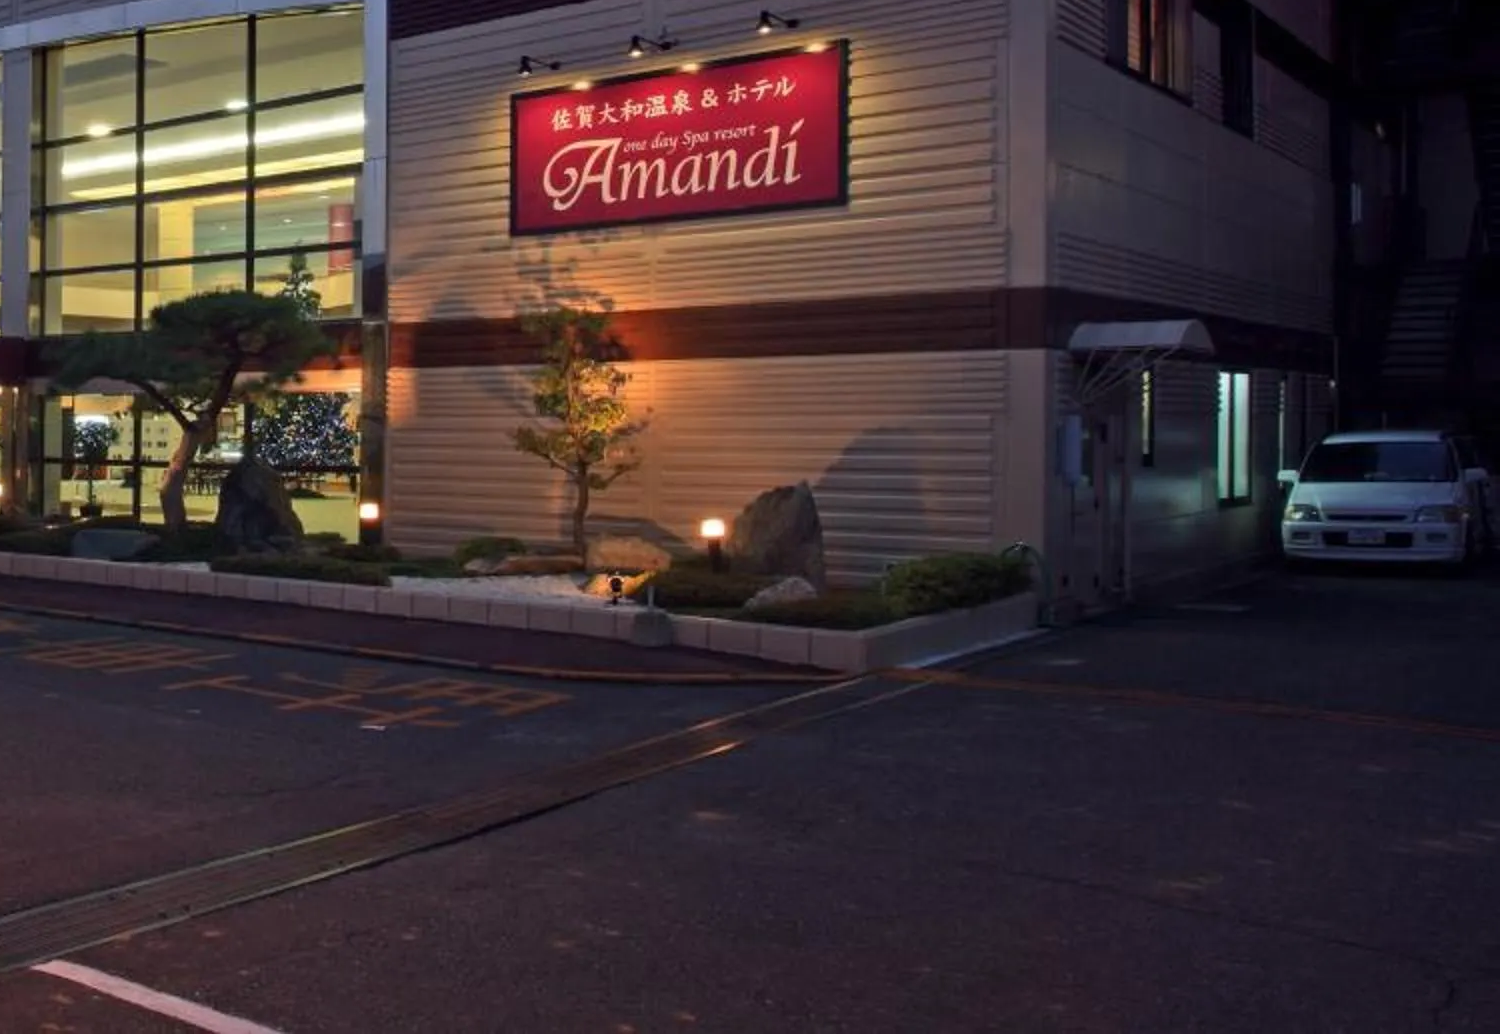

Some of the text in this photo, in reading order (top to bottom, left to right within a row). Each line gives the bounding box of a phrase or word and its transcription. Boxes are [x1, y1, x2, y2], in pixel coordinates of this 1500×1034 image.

[551, 76, 796, 132] 佐賀大和温泉 & ホテル
[623, 124, 757, 155] one day Spa resort
